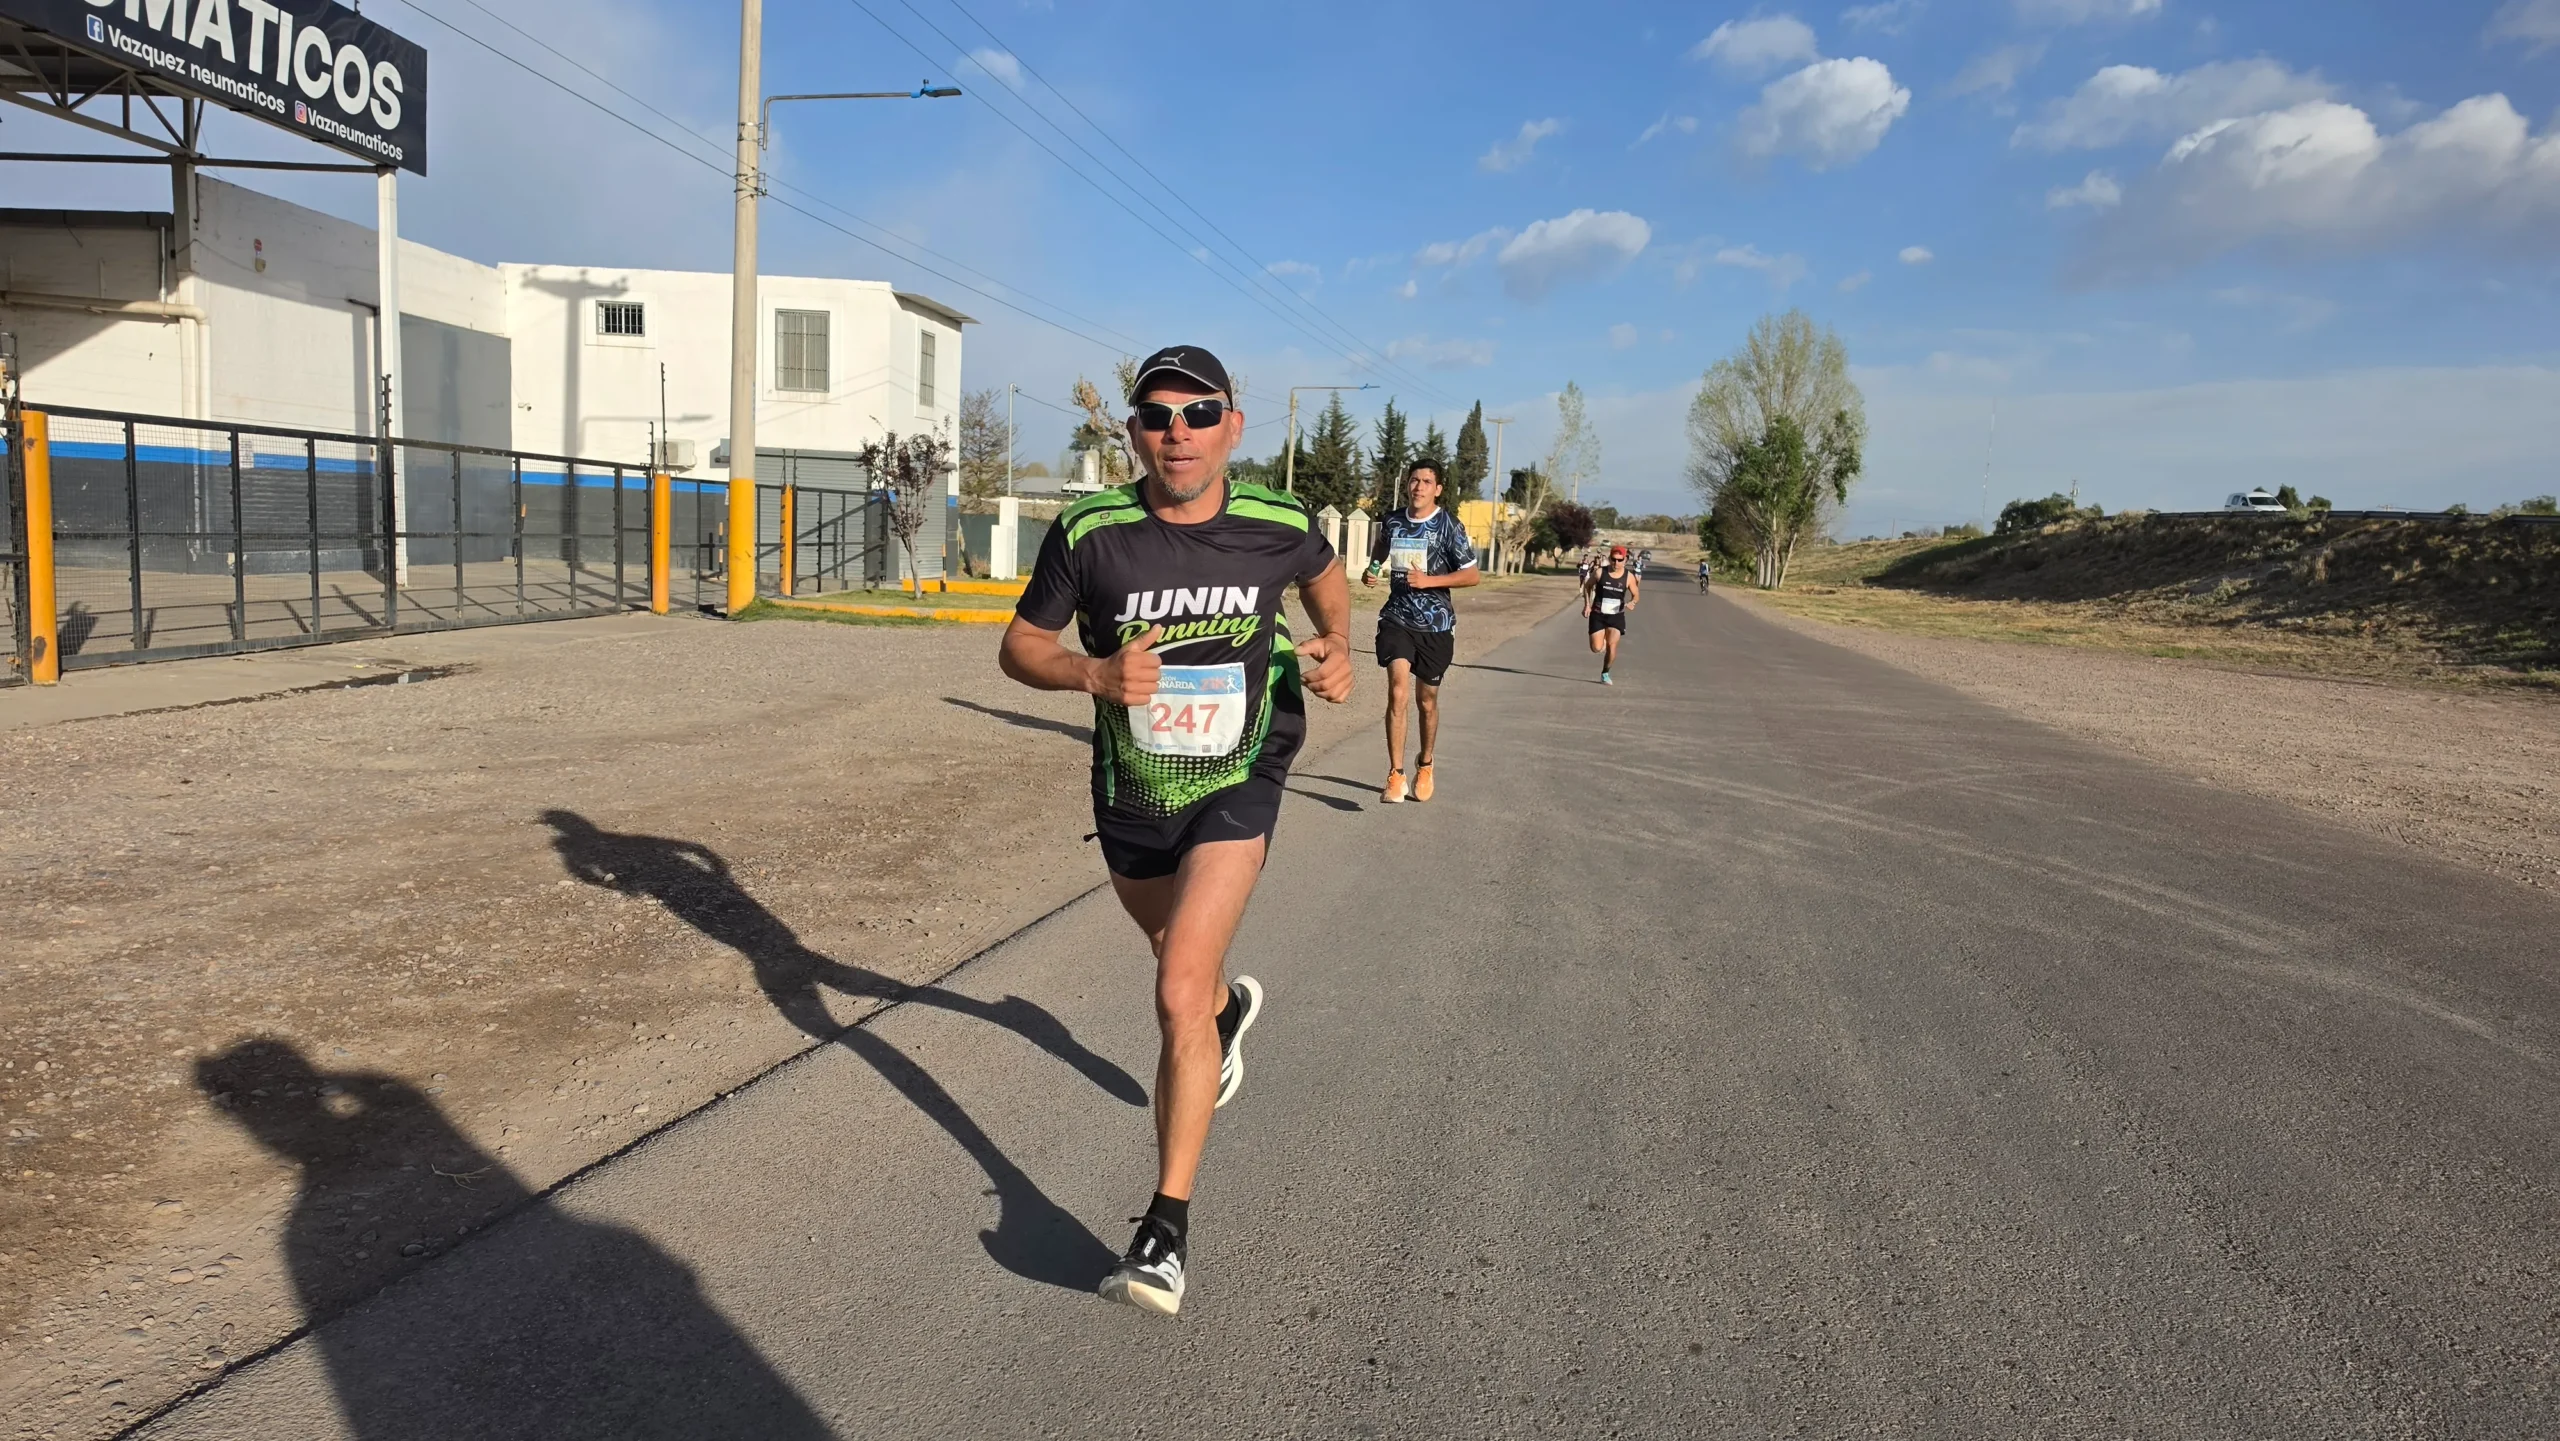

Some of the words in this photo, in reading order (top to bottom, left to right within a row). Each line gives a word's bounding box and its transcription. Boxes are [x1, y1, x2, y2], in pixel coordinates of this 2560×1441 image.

[83, 0, 403, 130] ATICOS
[107, 25, 186, 75] Vazquez
[190, 62, 286, 115] neumaticos
[307, 107, 403, 161] Vazneumaticos
[1114, 586, 1259, 622] JUNIN
[1151, 702, 1220, 734] 247
